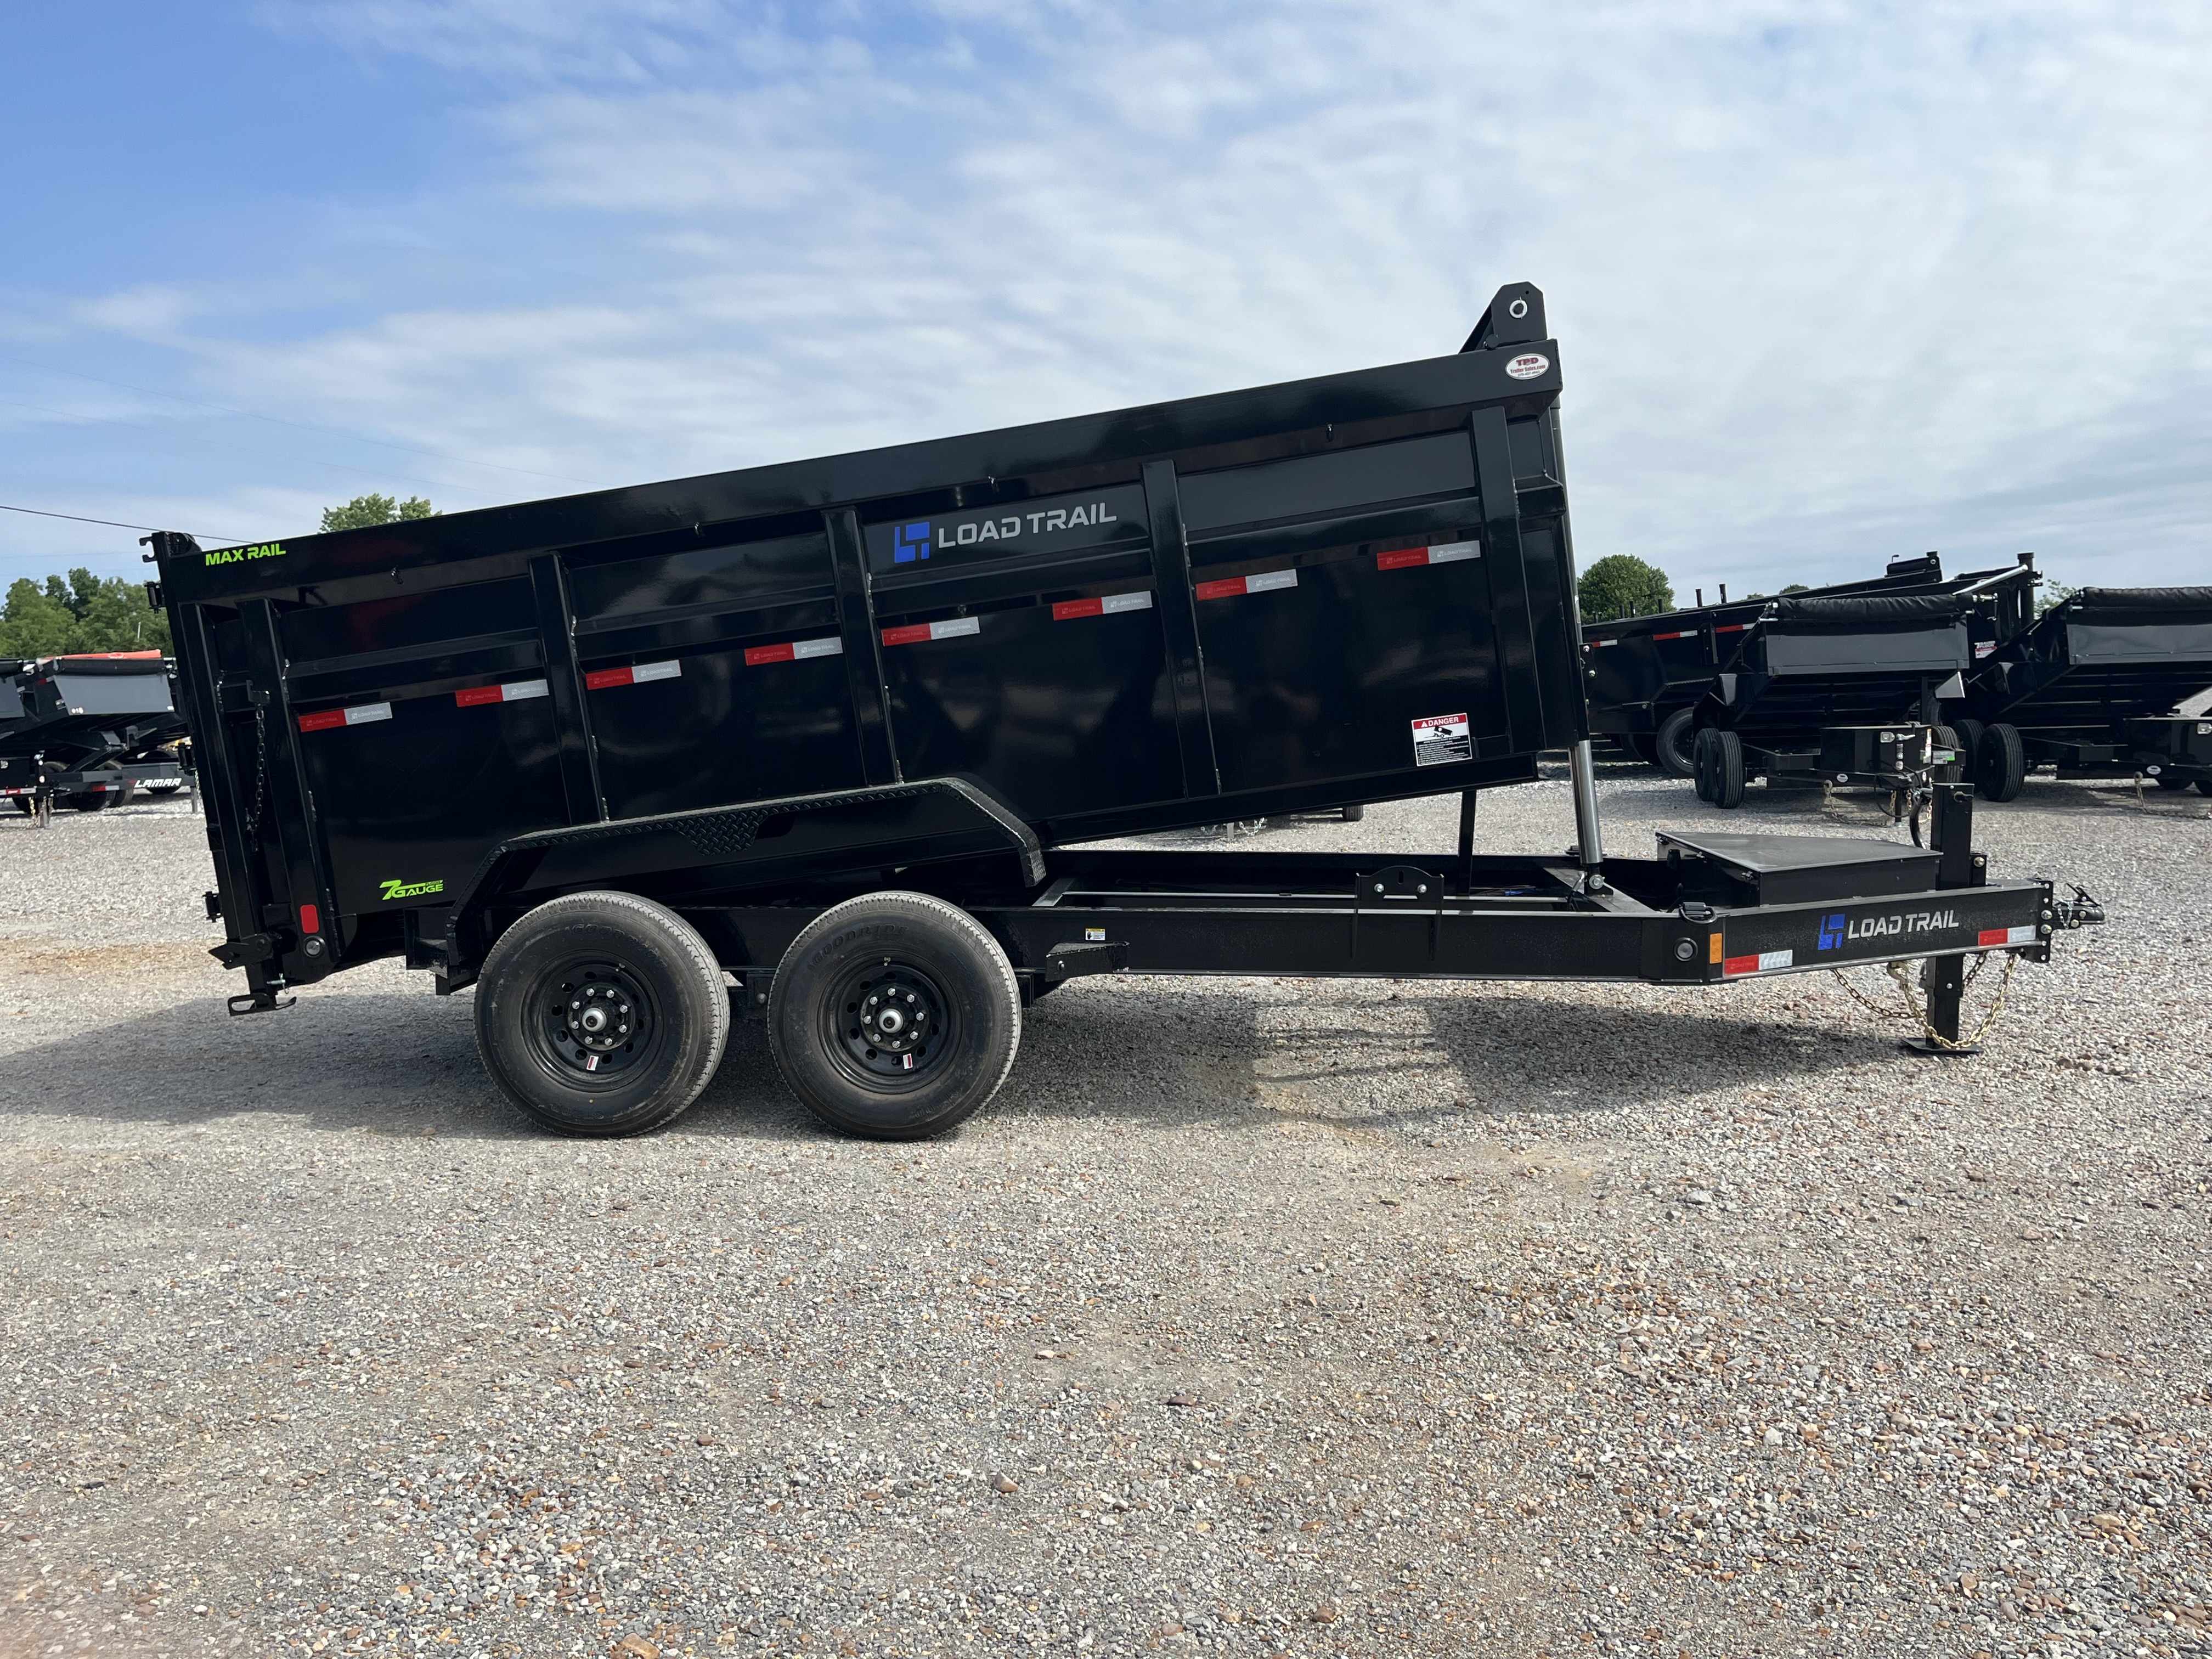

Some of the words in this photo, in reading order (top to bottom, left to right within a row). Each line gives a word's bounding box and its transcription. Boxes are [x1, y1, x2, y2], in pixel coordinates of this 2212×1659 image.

[1516, 358, 1538, 366] TPD
[938, 517, 1021, 548] LOAD
[1026, 503, 1117, 533] TRAIL
[206, 549, 244, 566] MAX
[247, 543, 286, 560] RAIL
[1428, 717, 1459, 726] DANGER
[134, 777, 182, 788] LAMAR
[380, 879, 402, 900] 7
[391, 884, 444, 898] GAUGE
[1848, 915, 1902, 939] LOAD
[1905, 910, 1960, 932] TRAIL
